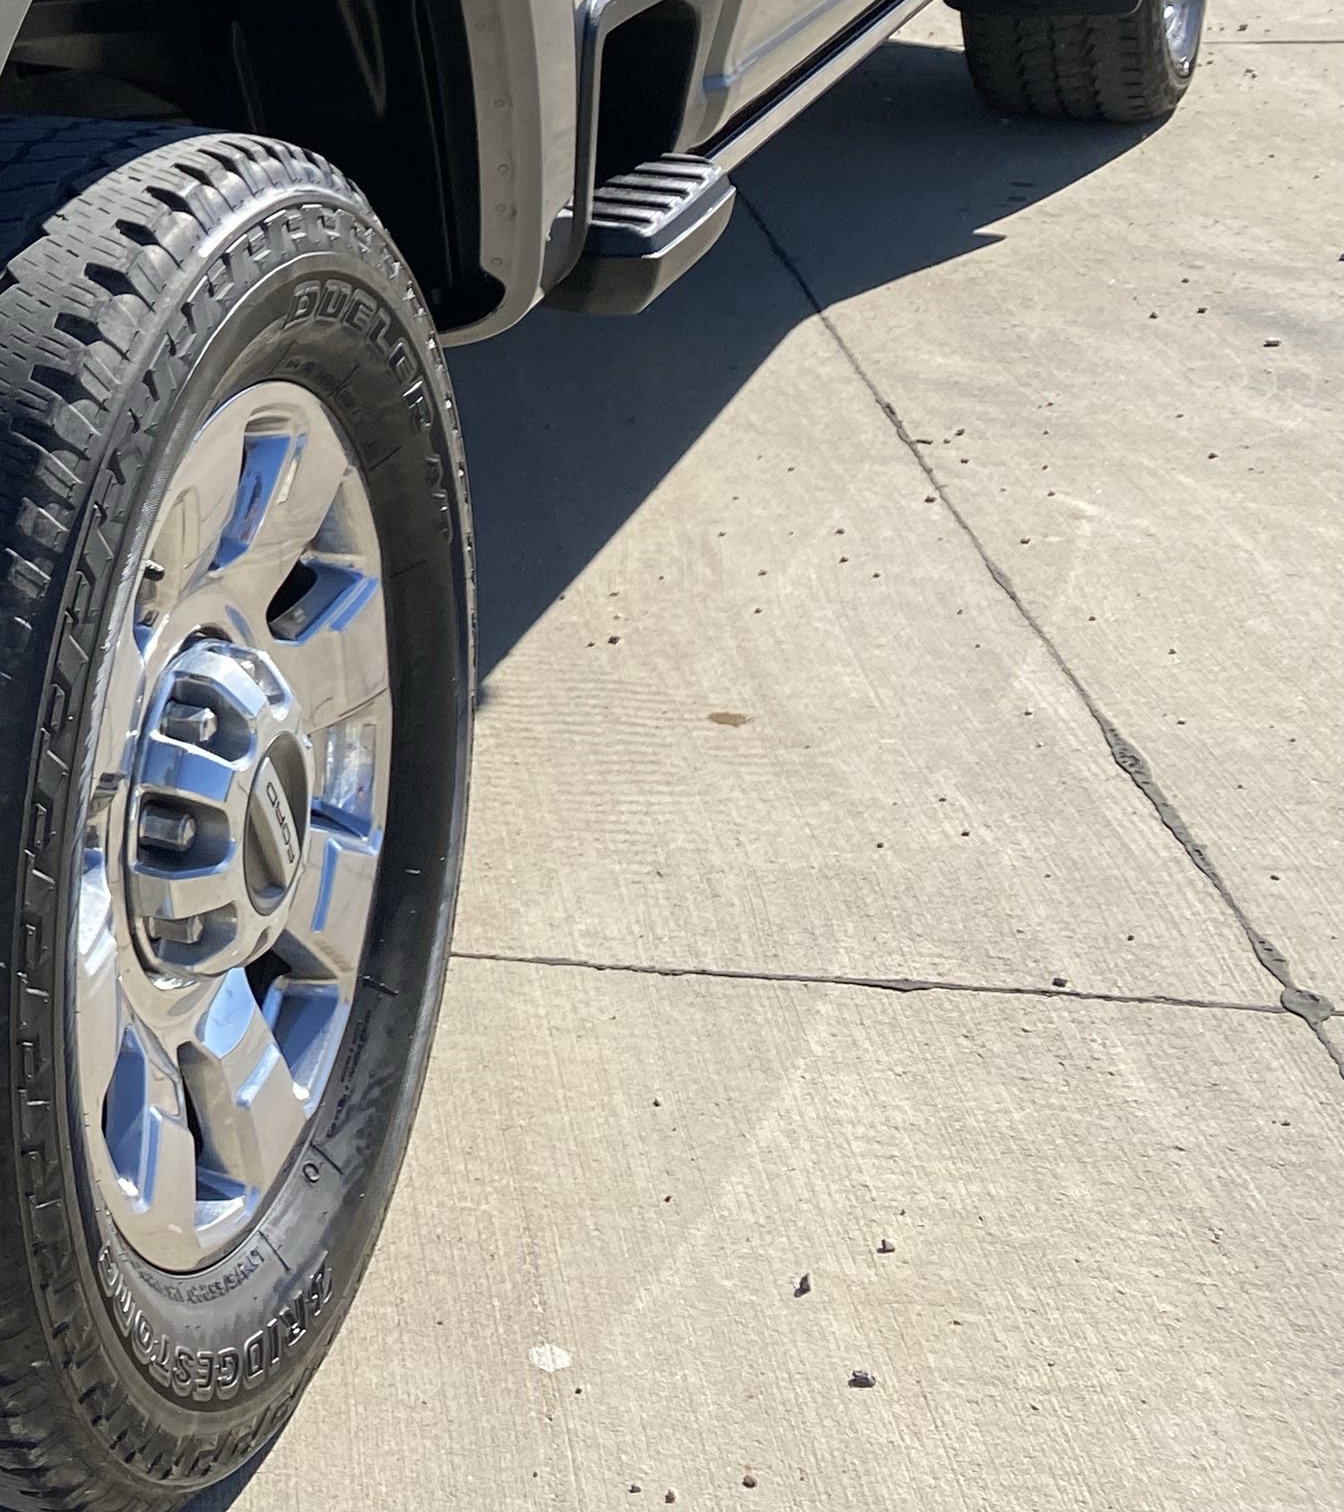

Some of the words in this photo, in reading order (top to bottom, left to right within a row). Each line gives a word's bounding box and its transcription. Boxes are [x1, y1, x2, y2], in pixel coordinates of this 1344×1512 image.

[282, 279, 434, 434] DUELER
[266, 781, 295, 864] FORD
[98, 1244, 333, 1402] BRIDGESTONE
